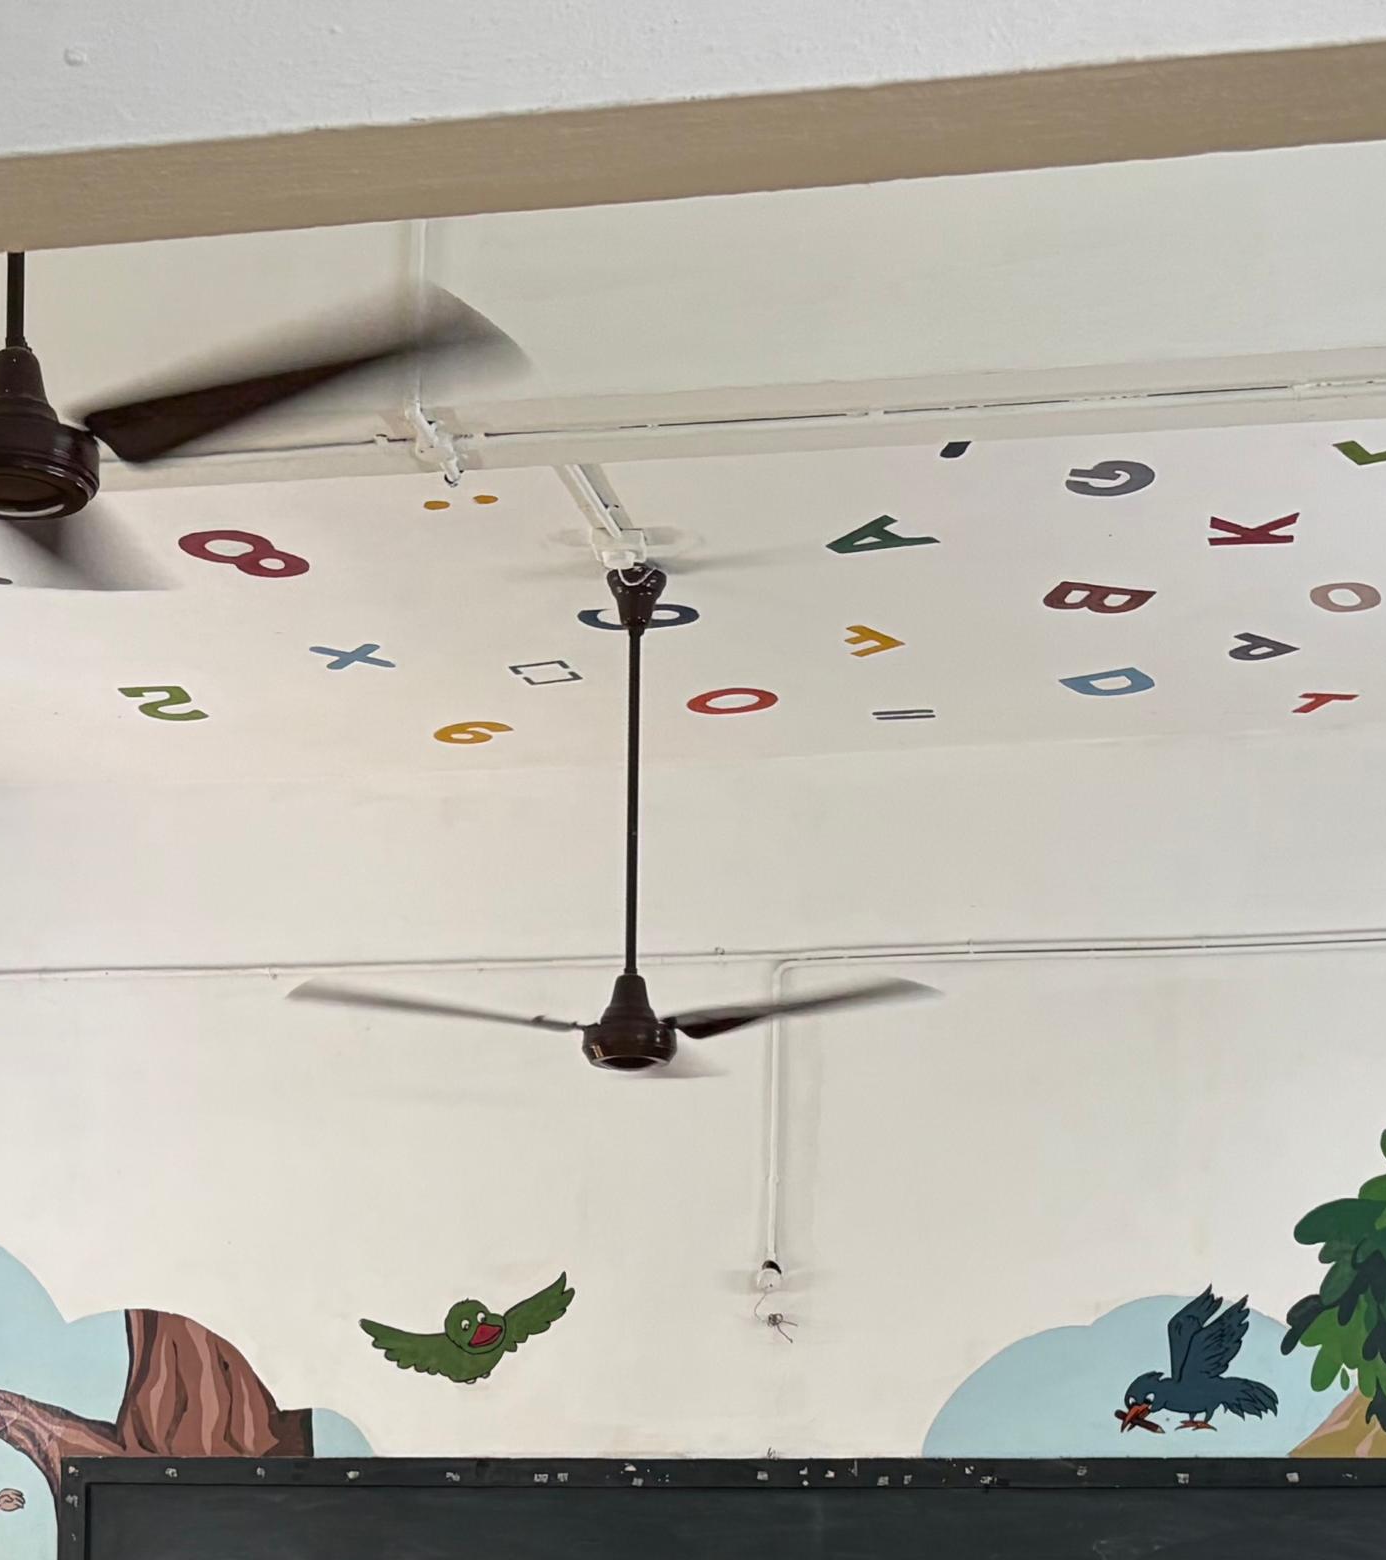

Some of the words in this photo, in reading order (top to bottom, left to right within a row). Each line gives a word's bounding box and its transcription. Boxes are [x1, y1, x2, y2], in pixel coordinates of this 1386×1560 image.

[825, 514, 941, 554] A
[1208, 512, 1300, 546] K
[177, 529, 310, 578] 8
[1042, 581, 1157, 614] B
[844, 624, 906, 657] F
[1058, 666, 1156, 697] D
